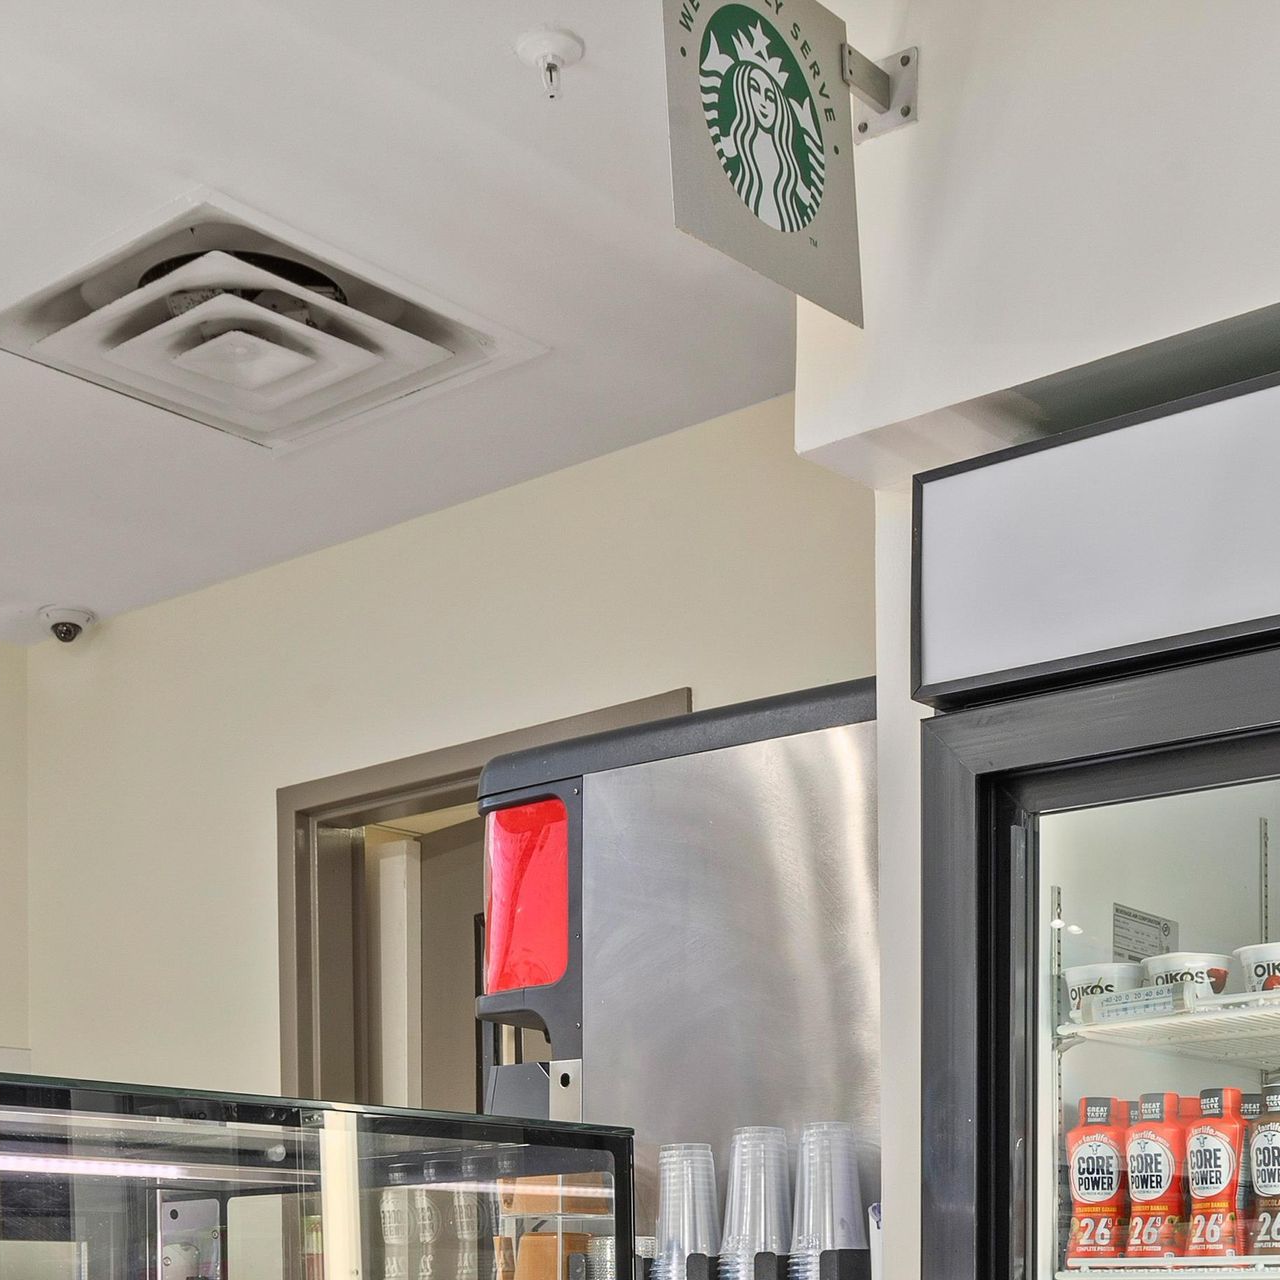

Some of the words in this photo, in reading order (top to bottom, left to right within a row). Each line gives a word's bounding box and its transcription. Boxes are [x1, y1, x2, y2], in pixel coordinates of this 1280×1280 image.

[790, 22, 836, 122] SERVE
[1077, 1155, 1114, 1175] CORE
[1130, 1153, 1162, 1173] CORE
[1190, 1148, 1222, 1169] CORE
[1078, 1176, 1113, 1191] POWER
[1131, 1174, 1163, 1189] POWER
[1191, 1170, 1222, 1185] POWER
